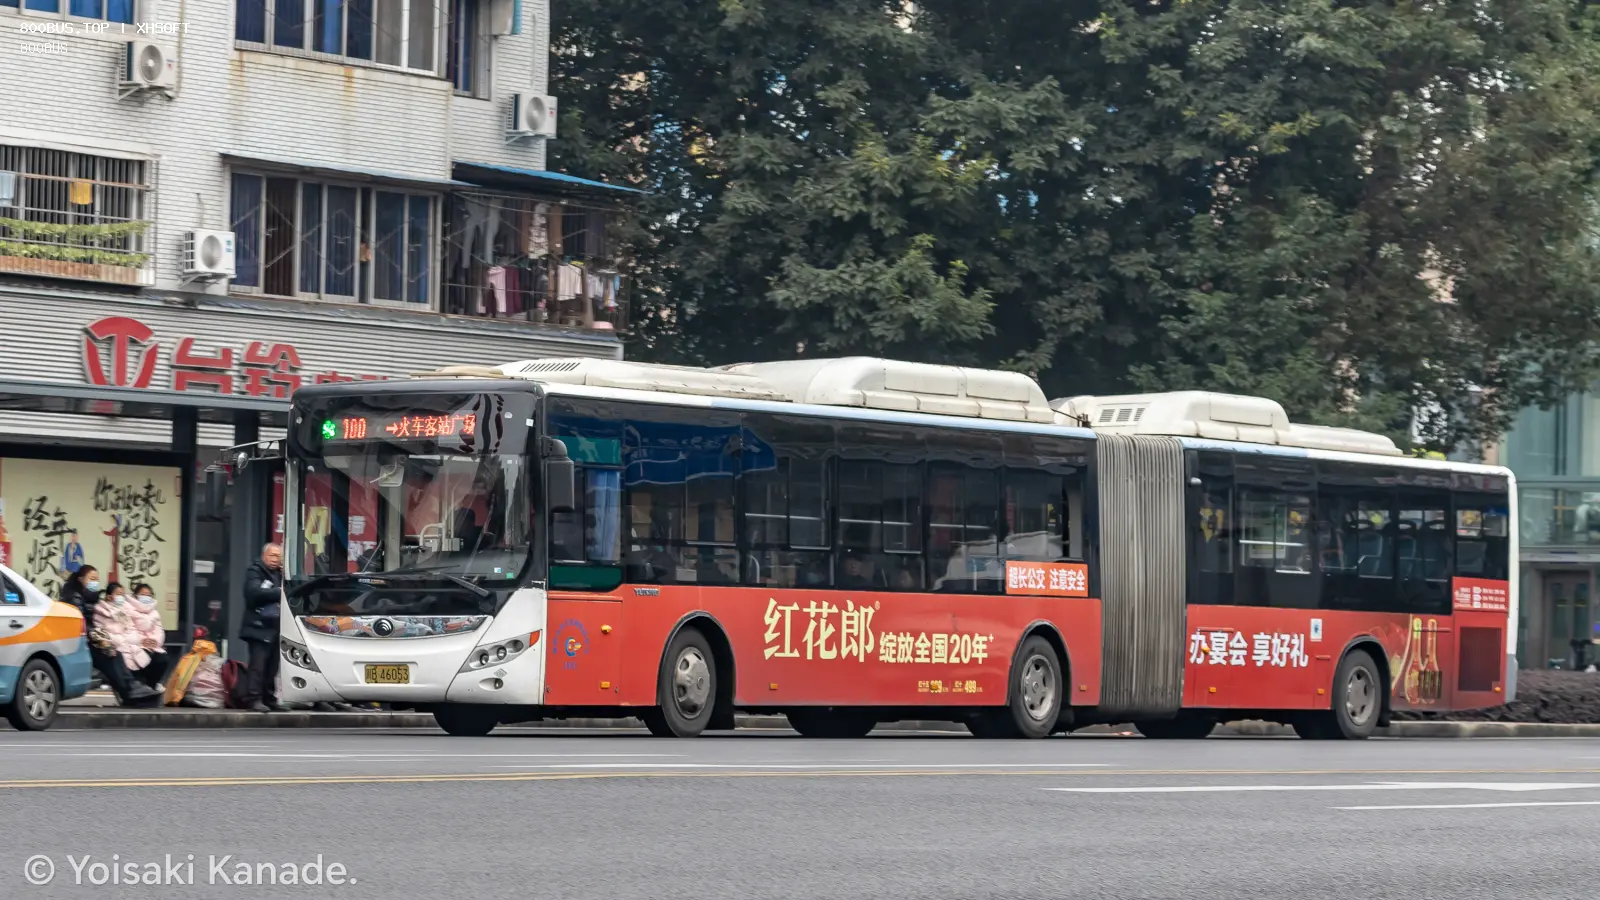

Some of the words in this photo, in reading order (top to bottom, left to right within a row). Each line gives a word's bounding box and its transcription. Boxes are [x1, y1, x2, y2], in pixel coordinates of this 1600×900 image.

[342, 418, 367, 439] 100
[397, 414, 476, 438] 火车客站广场
[1008, 566, 1046, 590] 超长公交
[1049, 568, 1086, 591] 注意安全
[1189, 631, 1248, 667] 办宴会
[1251, 632, 1309, 668] 享好礼
